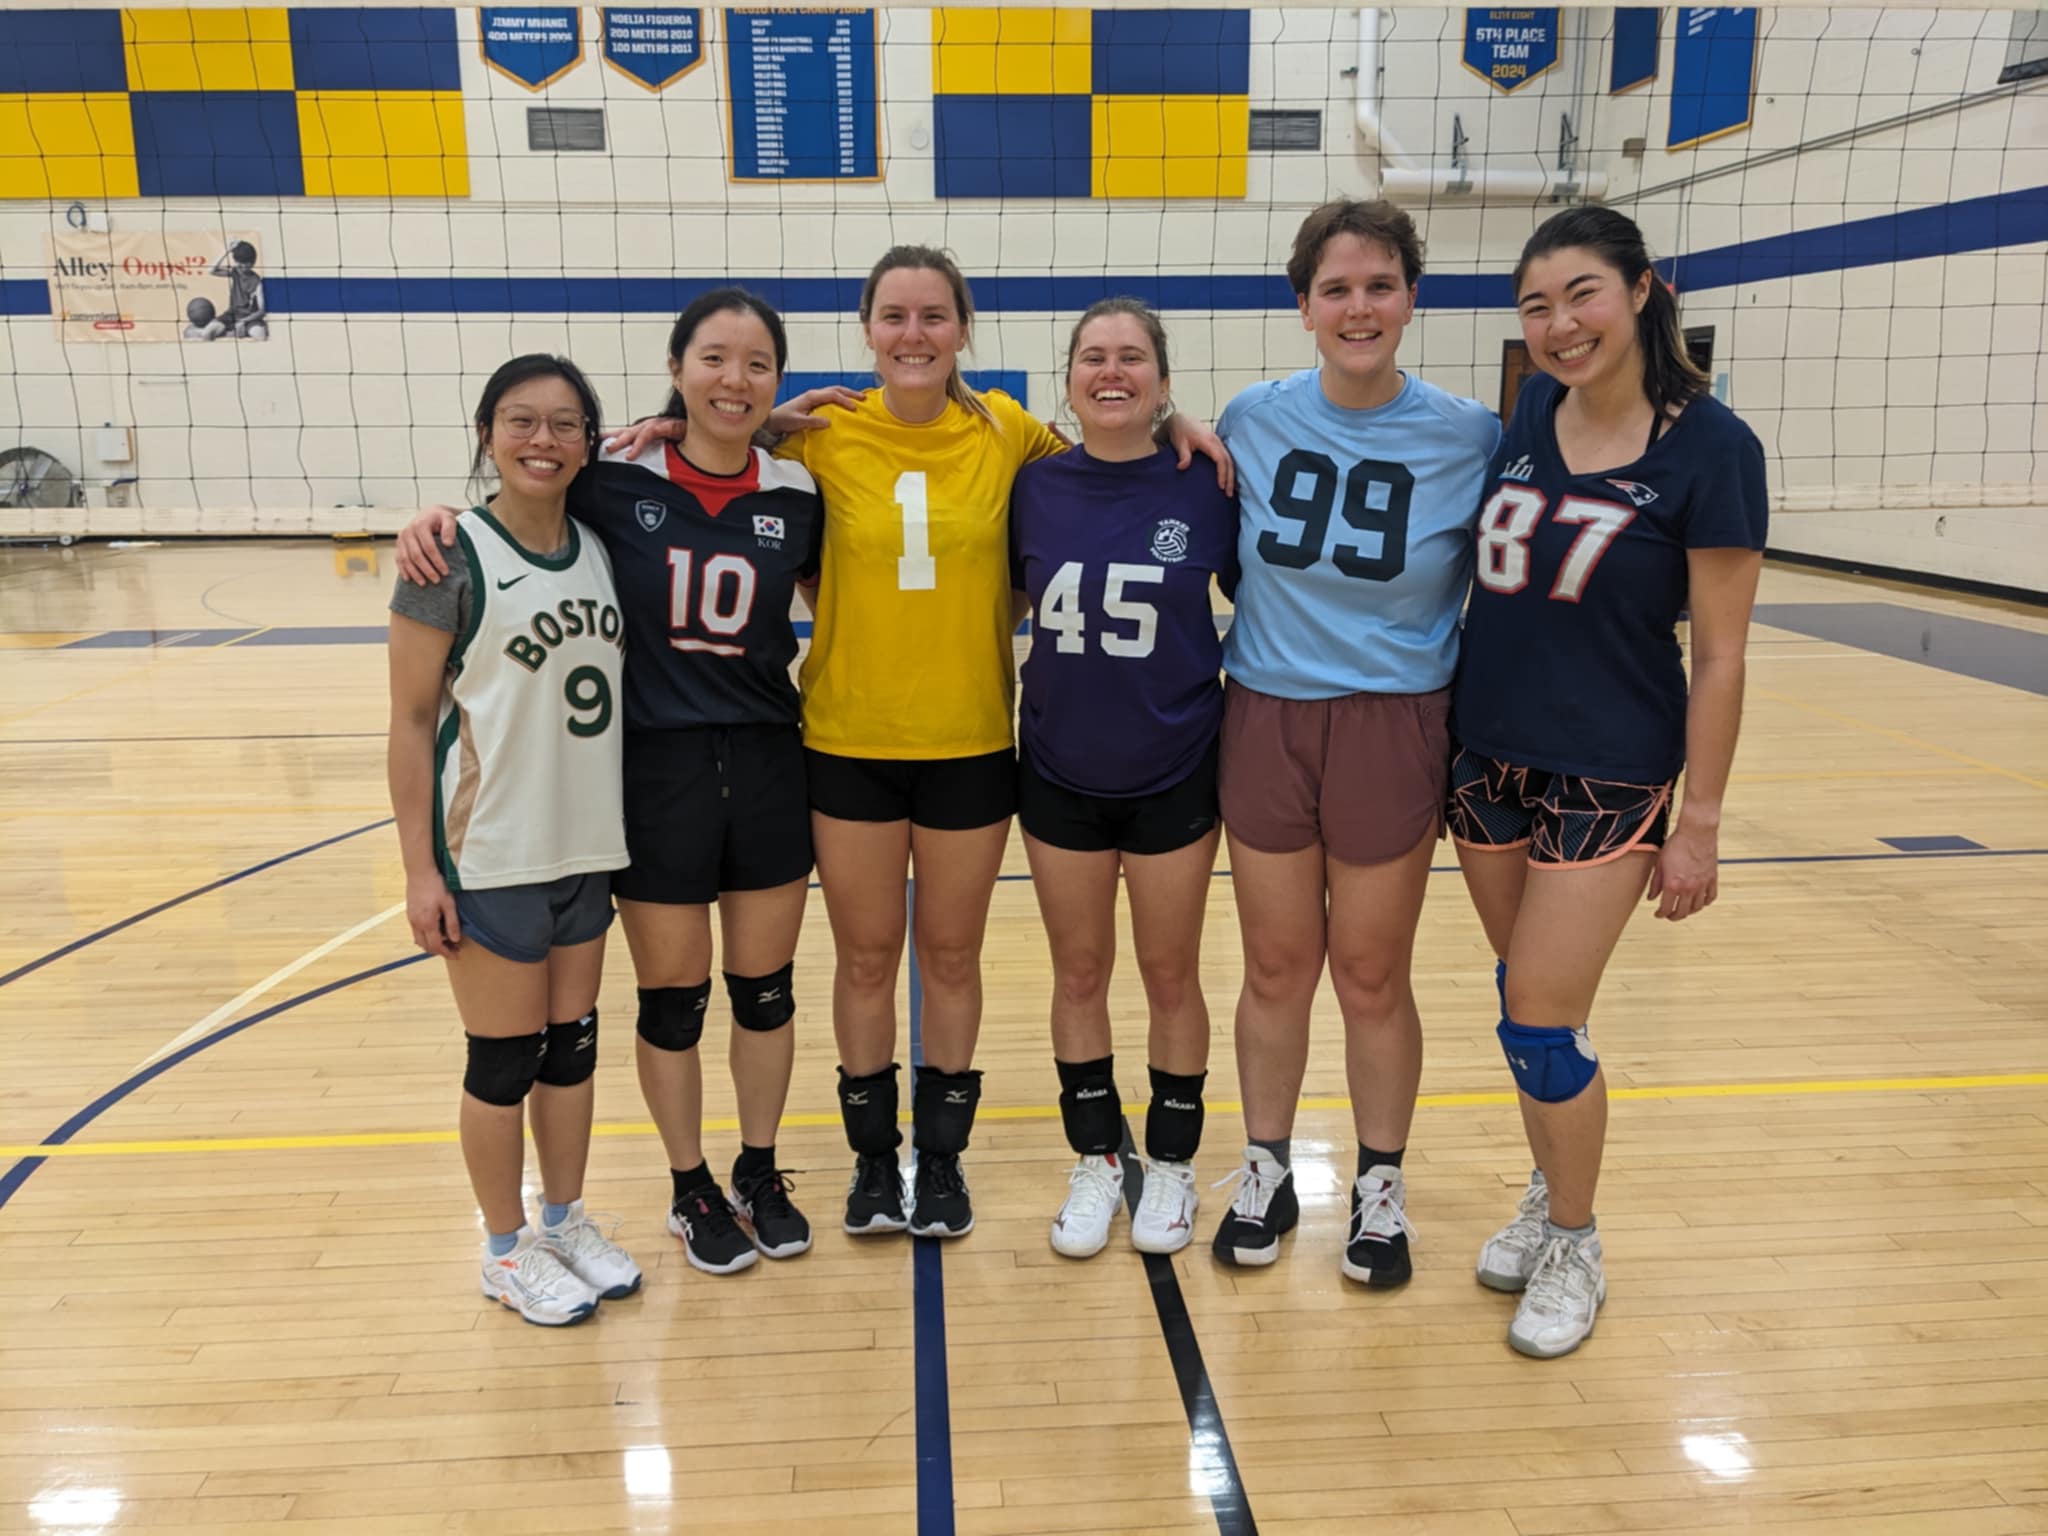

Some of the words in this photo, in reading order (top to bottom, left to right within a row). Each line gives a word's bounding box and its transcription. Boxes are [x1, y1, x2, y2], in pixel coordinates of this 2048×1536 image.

[492, 17, 526, 28] JIMMY
[610, 14, 644, 25] NOELIA
[646, 15, 692, 25] FIGUEROA
[509, 32, 547, 43] METERS
[610, 28, 630, 39] 200
[631, 29, 669, 40] METERS
[670, 29, 693, 40] 2010
[1476, 27, 1502, 42] 5TH
[1505, 27, 1546, 42] PLACE
[612, 42, 630, 53] 100
[632, 43, 669, 54] METERS
[671, 43, 692, 54] 2011
[1493, 44, 1530, 58] TEAM
[1492, 64, 1527, 78] 2024
[54, 256, 112, 281] Alley
[122, 255, 206, 281] Oops!?
[1256, 448, 1415, 582] 99
[894, 470, 936, 590] 1
[757, 537, 782, 551] KOR
[1477, 483, 1638, 604] 87
[667, 546, 757, 636] 10
[1039, 561, 1165, 658] 45
[564, 665, 613, 738] 9
